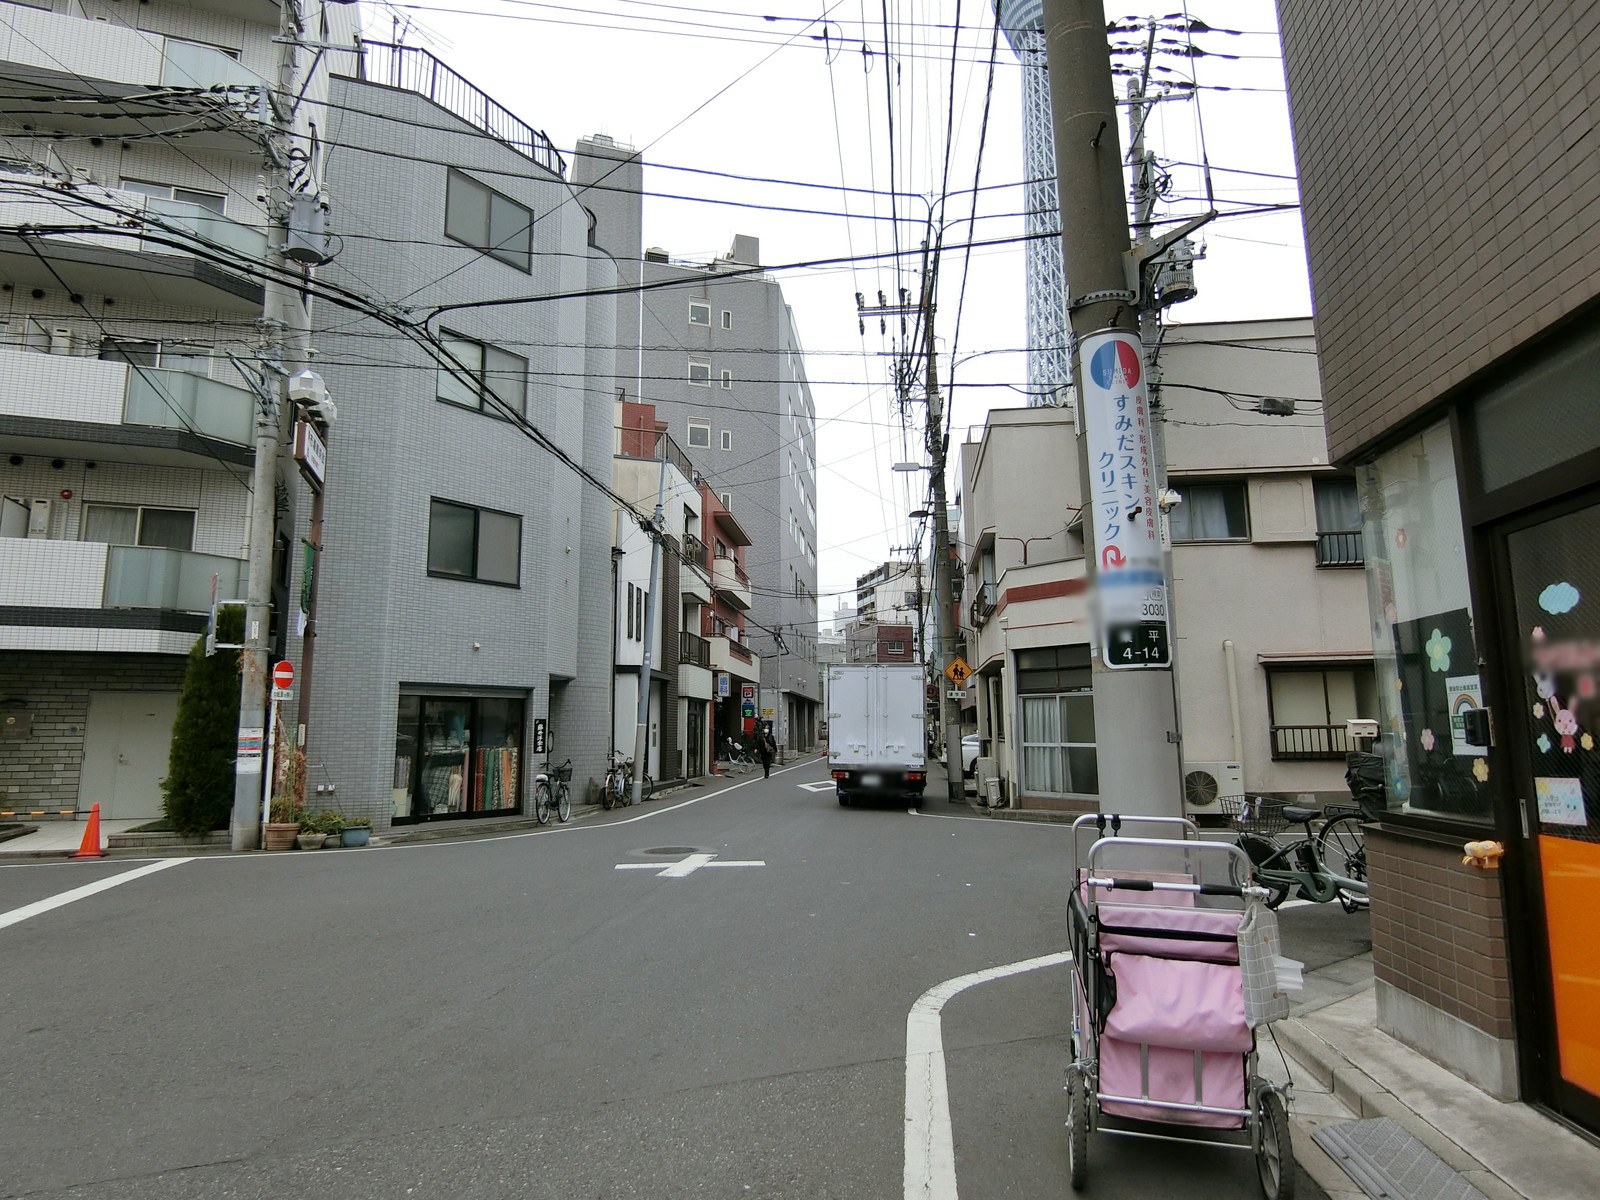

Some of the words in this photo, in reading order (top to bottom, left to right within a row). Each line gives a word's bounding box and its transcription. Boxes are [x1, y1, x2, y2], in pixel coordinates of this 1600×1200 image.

[1102, 367, 1132, 377] SUMIDA
[1113, 395, 1140, 510] すみだスキン
[1135, 395, 1155, 541] 皮膚科・形成外科・美容皮膚科
[1098, 451, 1120, 541] クリニック
[1122, 646, 1160, 660] 4-14
[719, 676, 728, 694] 歯科
